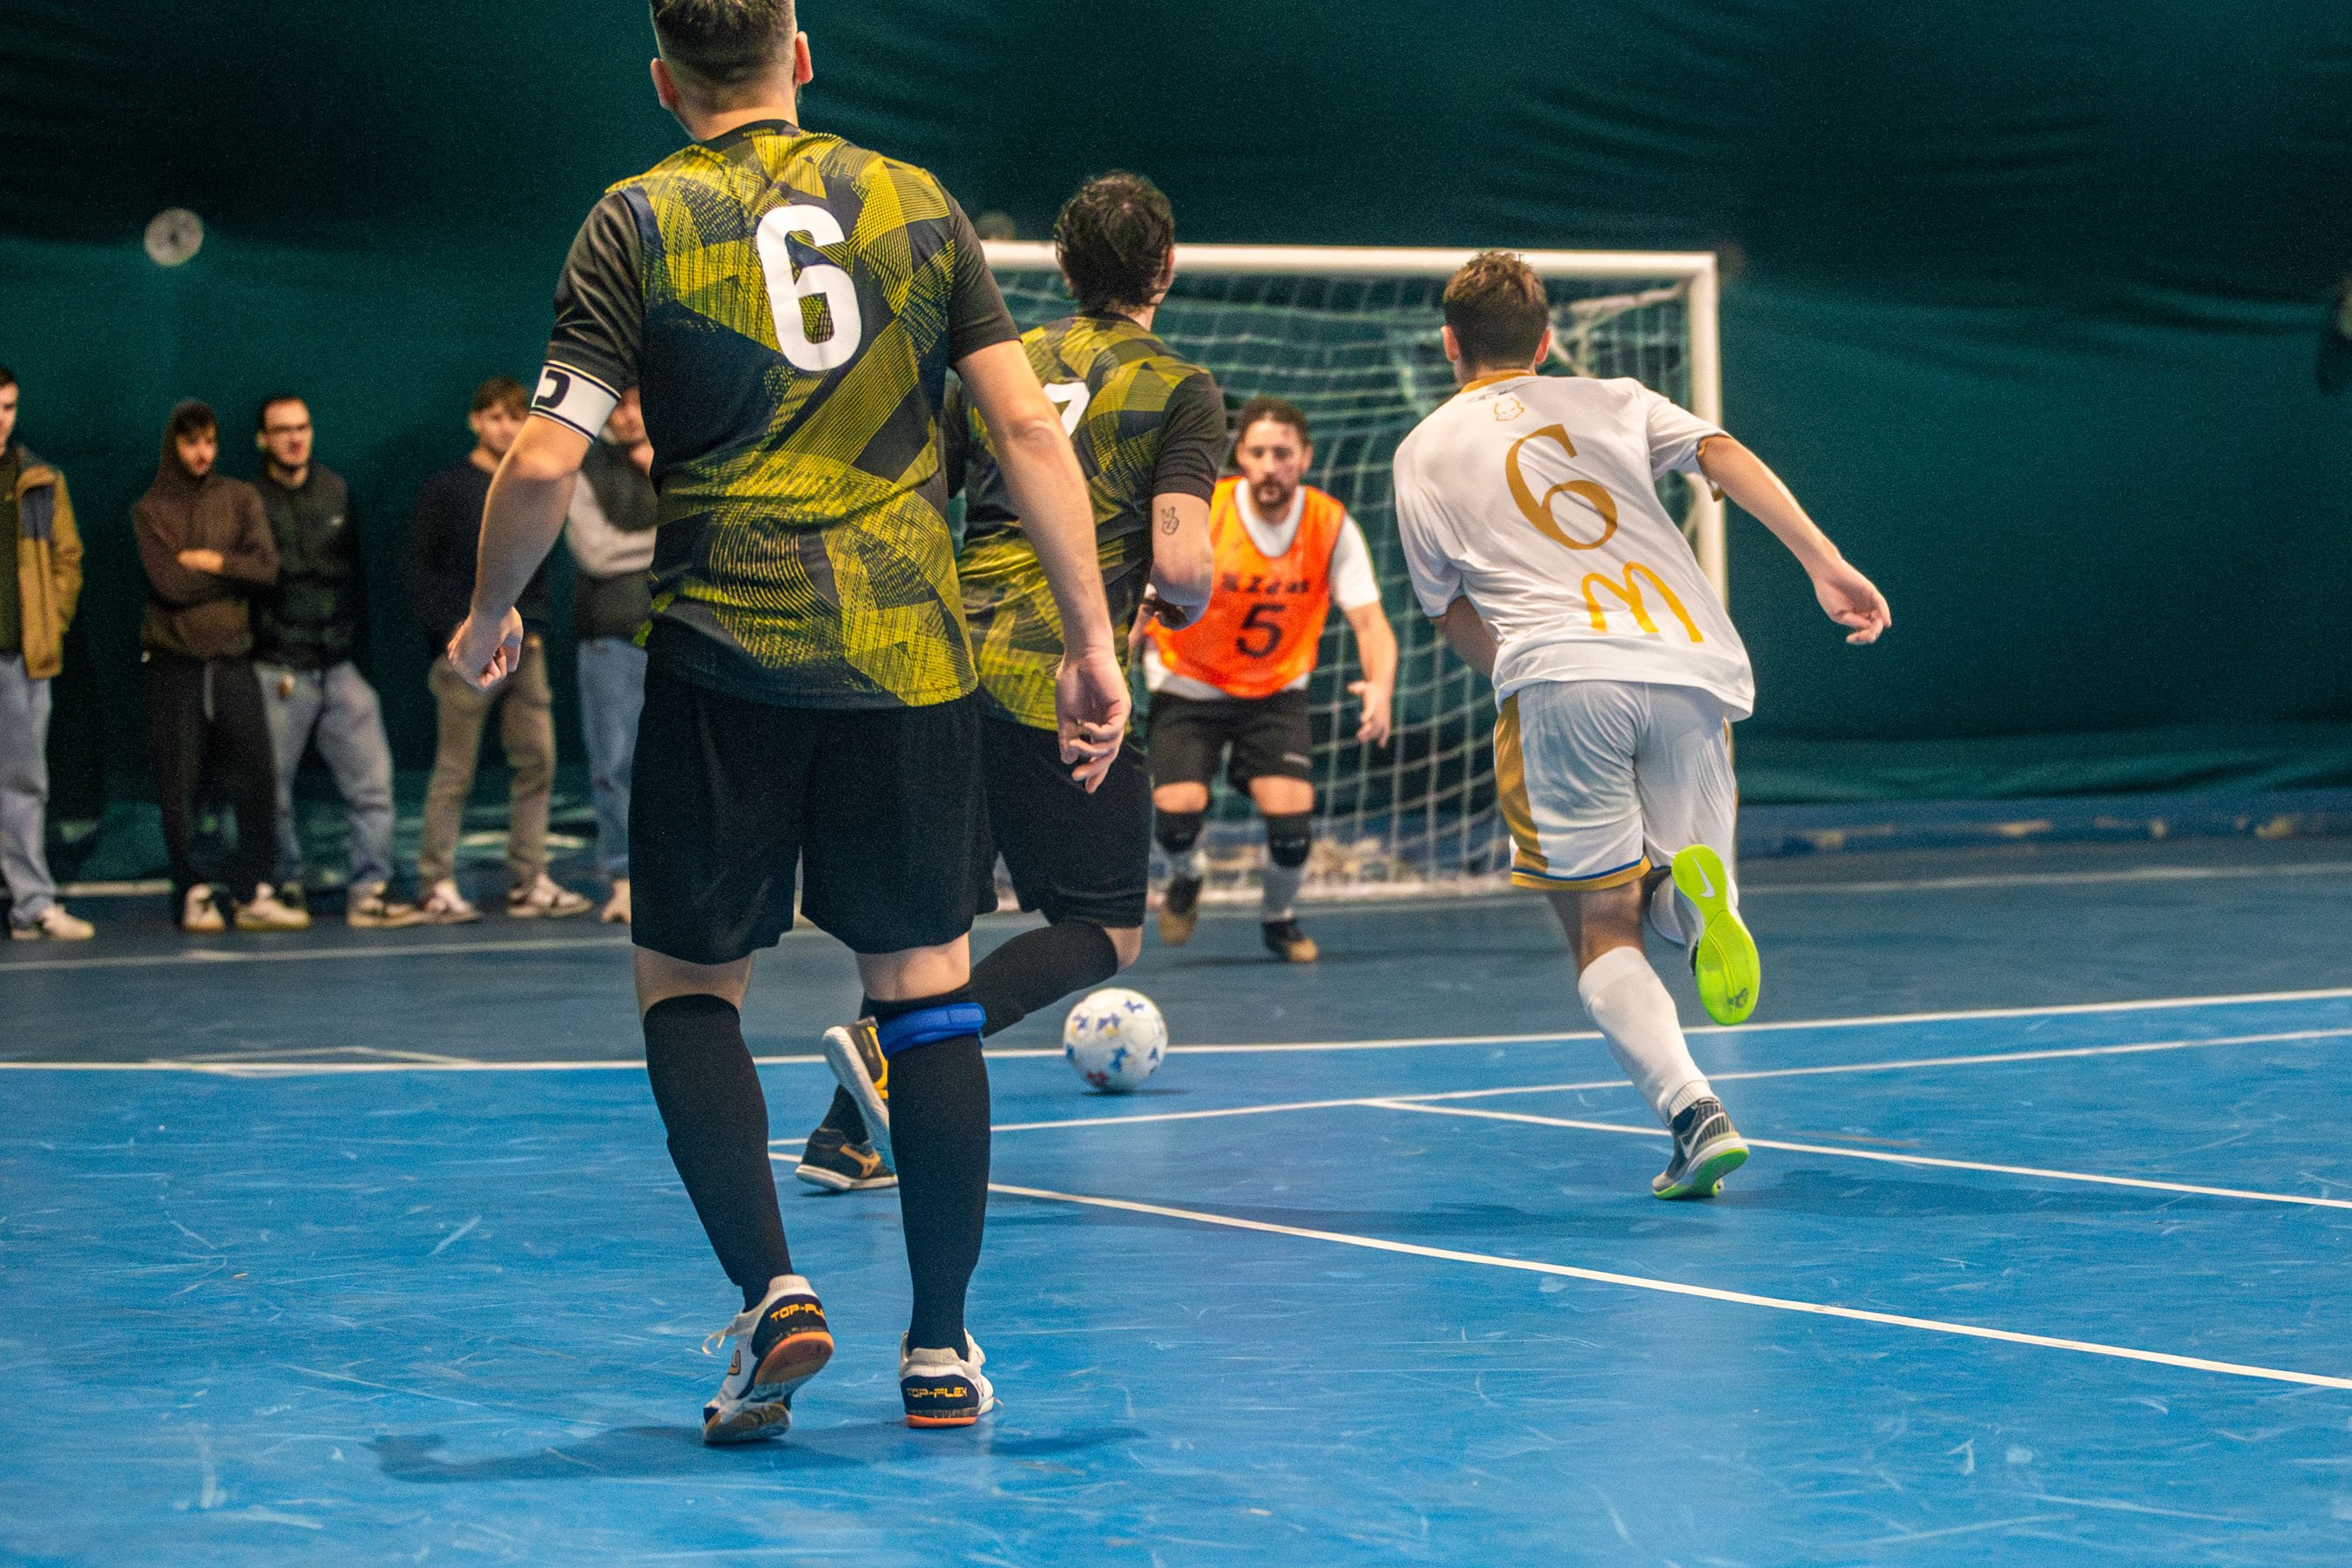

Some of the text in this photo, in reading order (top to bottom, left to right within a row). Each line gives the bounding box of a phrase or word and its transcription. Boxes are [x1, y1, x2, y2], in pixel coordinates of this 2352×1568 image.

[756, 204, 862, 372] 6
[1505, 423, 1618, 550] 6
[1236, 603, 1287, 659] 5
